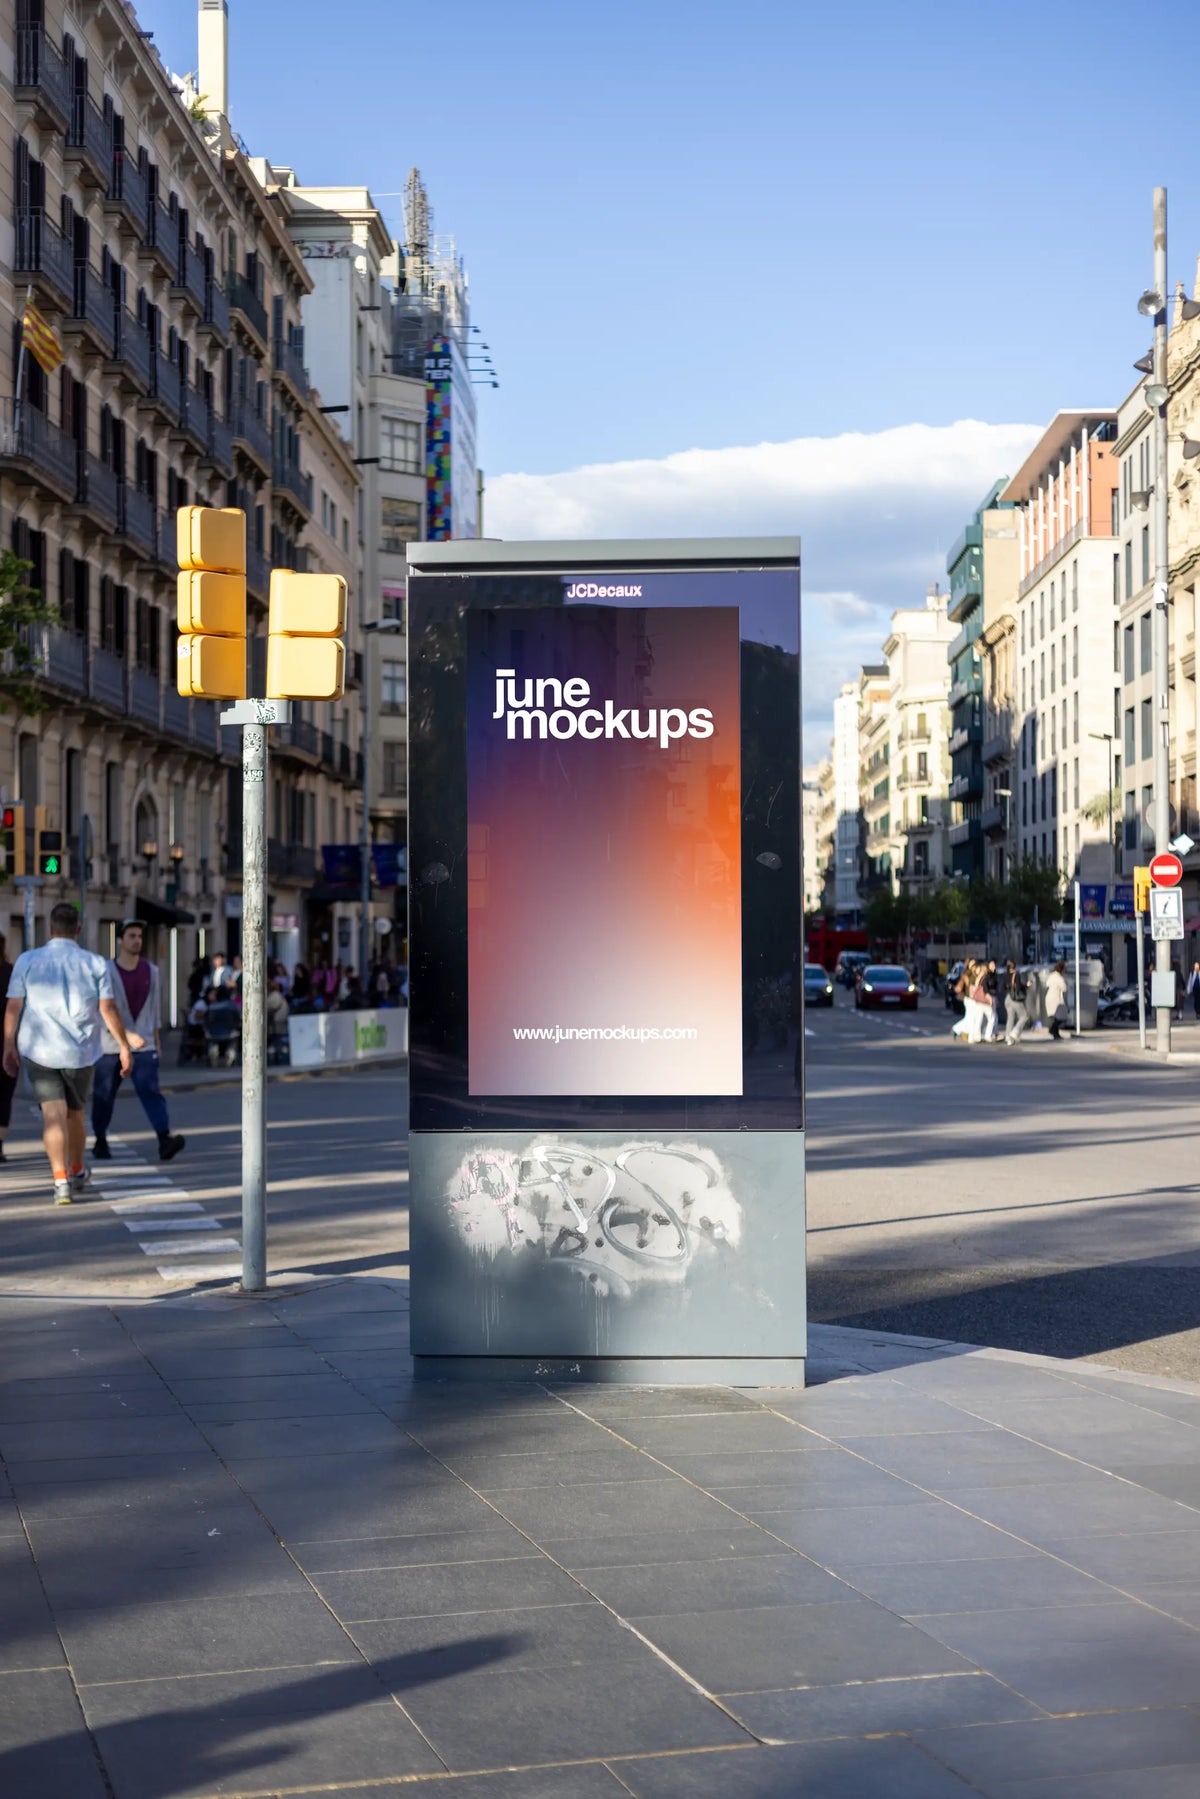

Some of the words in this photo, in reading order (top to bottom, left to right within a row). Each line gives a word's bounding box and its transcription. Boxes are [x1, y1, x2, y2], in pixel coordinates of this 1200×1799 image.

[566, 583, 643, 599] JCDecaux
[492, 669, 591, 719] june
[505, 700, 715, 749] mockups
[512, 1024, 698, 1044] www.junemockups.com
